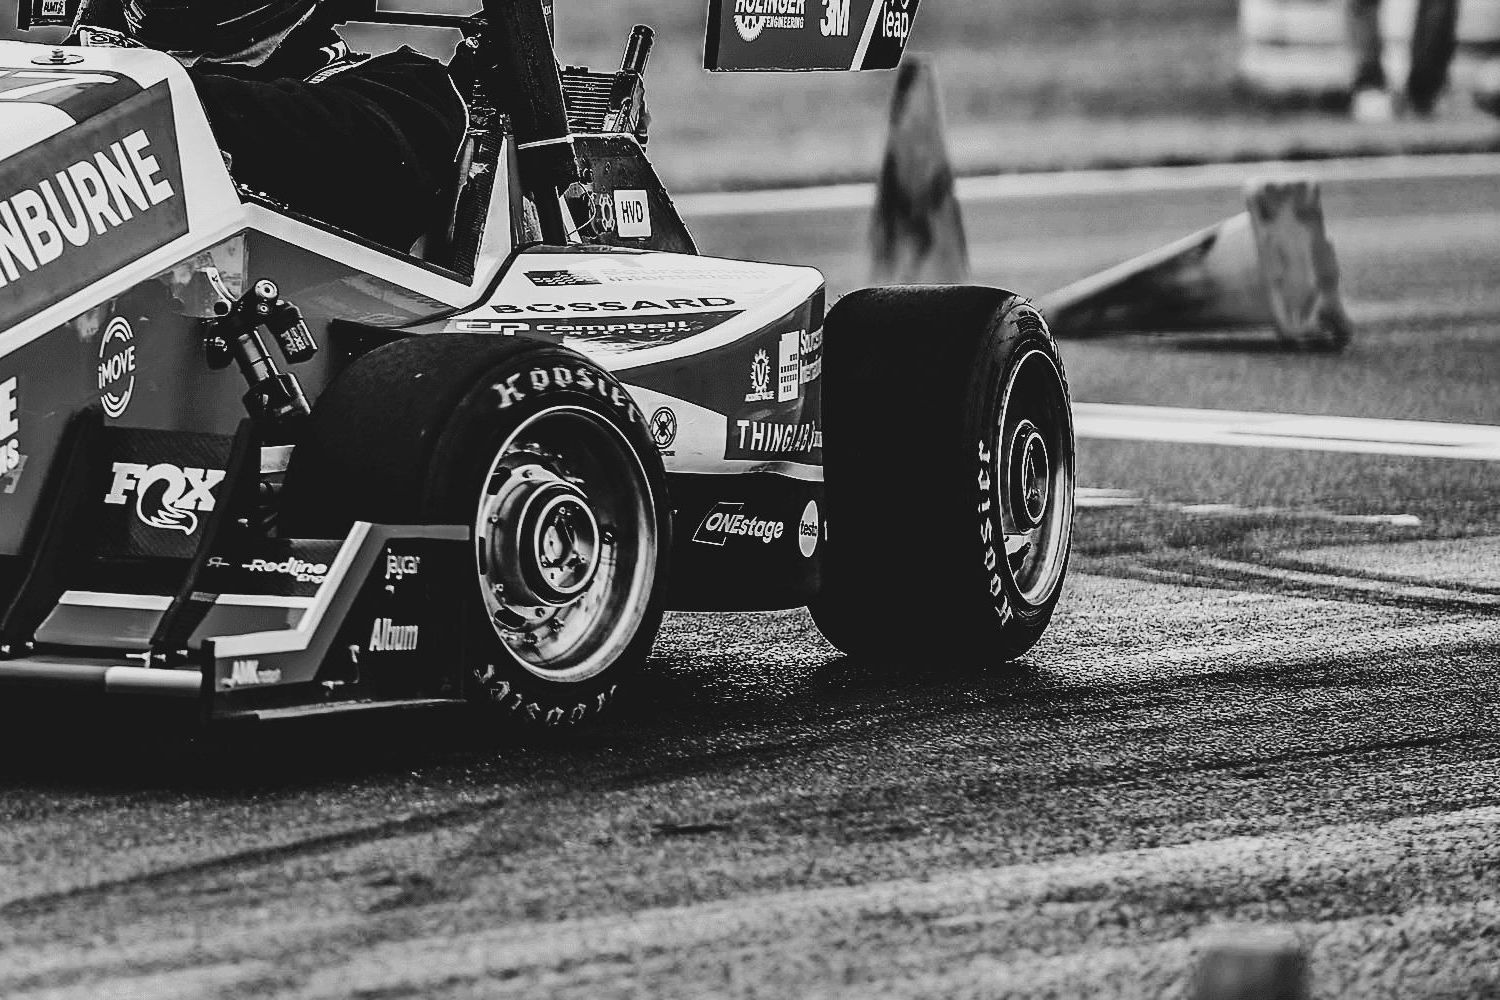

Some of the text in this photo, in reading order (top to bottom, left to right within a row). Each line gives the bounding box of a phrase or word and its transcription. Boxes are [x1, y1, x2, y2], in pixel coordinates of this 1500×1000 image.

[765, 16, 805, 28] ENGINEERING
[882, 1, 909, 47] leap
[620, 200, 643, 224] HVD
[490, 297, 736, 314] BOSSARD
[98, 345, 136, 389] iMOVE
[104, 462, 227, 535] FOX
[705, 512, 784, 543] ONEstage
[244, 556, 328, 576] Redline
